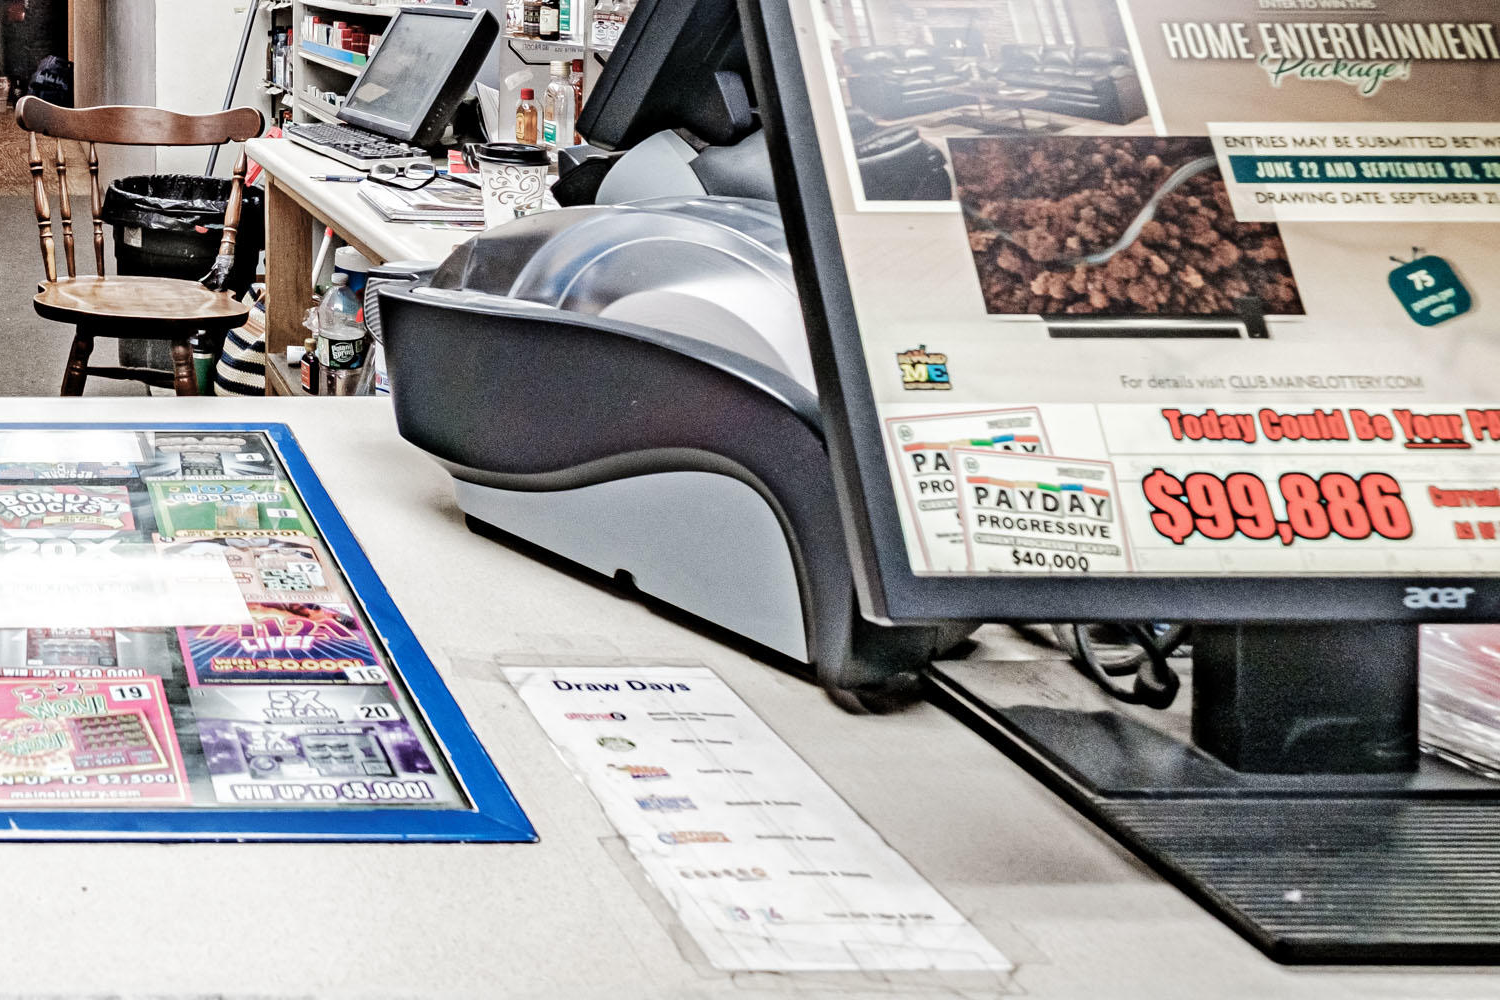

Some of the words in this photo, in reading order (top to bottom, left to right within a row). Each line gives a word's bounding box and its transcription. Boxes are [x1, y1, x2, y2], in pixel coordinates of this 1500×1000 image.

[1161, 22, 1255, 60] HOME
[1258, 22, 1500, 60] ENTERTAINMENT
[1224, 136, 1288, 148] ENTRIES
[1292, 136, 1328, 148] MAY
[1334, 136, 1355, 148] BE
[1358, 136, 1447, 149] SUBMITTED
[1257, 162, 1296, 178] JUNE
[1299, 162, 1321, 178] 22
[1325, 162, 1357, 178] AND
[1360, 162, 1448, 179] SEPTEMBER
[1255, 192, 1336, 204] DRAWING
[1390, 192, 1484, 204] SEPTEMBER
[900, 364, 949, 383] ME
[1120, 376, 1145, 388] For
[1147, 375, 1195, 388] details
[1198, 375, 1226, 388] visit
[1229, 376, 1425, 390] CLUB.MAINELOTTERY.COM
[1161, 409, 1256, 443] Today
[1259, 409, 1350, 442] Could
[1350, 409, 1394, 442] Be
[1393, 409, 1466, 442] Your
[974, 486, 1106, 517] PAYDAY
[1142, 468, 1414, 546] $99,886
[977, 514, 1111, 539] PROGRESSIVE
[1402, 586, 1475, 610] acer
[241, 635, 315, 651] LIVE!
[116, 686, 143, 698] 19
[552, 680, 620, 691] Draw
[626, 680, 692, 693] Days
[359, 706, 389, 719] 20
[23, 776, 52, 786] UP
[61, 776, 88, 786] TO
[97, 774, 176, 785] $2,500!
[232, 784, 274, 800] WIN
[277, 784, 306, 800] UP
[309, 784, 337, 800] TO
[341, 781, 434, 800] $5,000!
